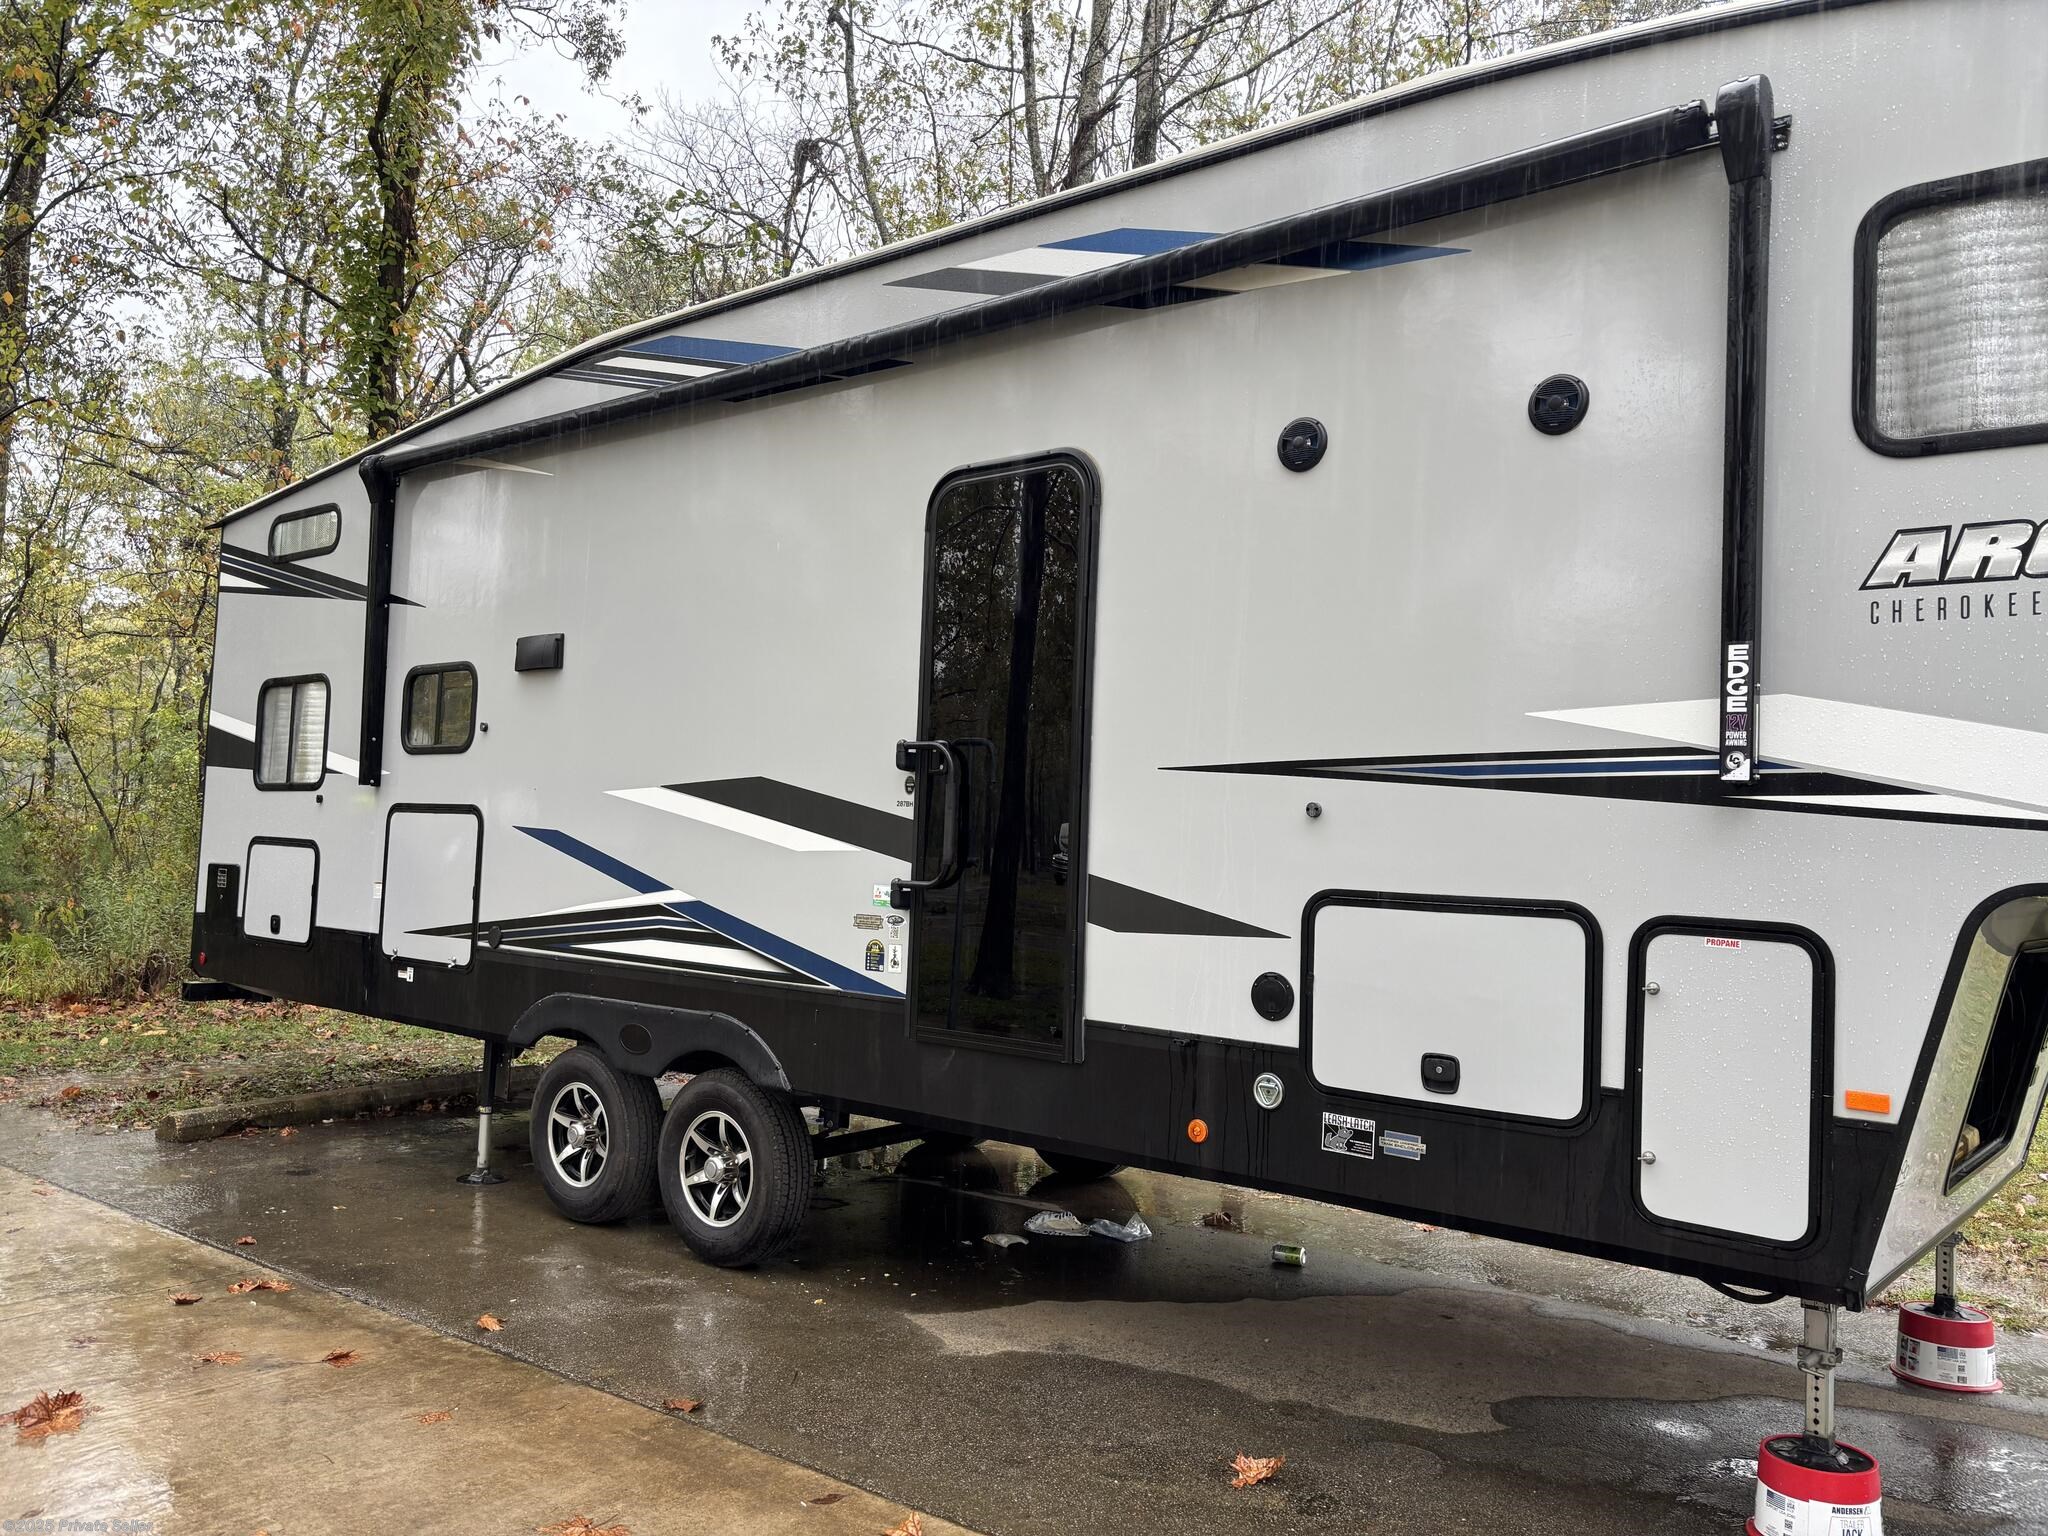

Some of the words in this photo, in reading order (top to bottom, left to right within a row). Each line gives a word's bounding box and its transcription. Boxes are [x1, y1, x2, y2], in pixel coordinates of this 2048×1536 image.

[1858, 518, 2048, 591] AR
[1870, 591, 2042, 625] CHEROKEE
[1726, 644, 1749, 713] EDGE
[1725, 731, 1747, 739] POWER
[1725, 739, 1748, 747] AWNING
[1706, 938, 1741, 948] PROPANE
[1831, 1506, 1864, 1515] ANDERSEN
[1840, 1519, 1865, 1529] TRAILER
